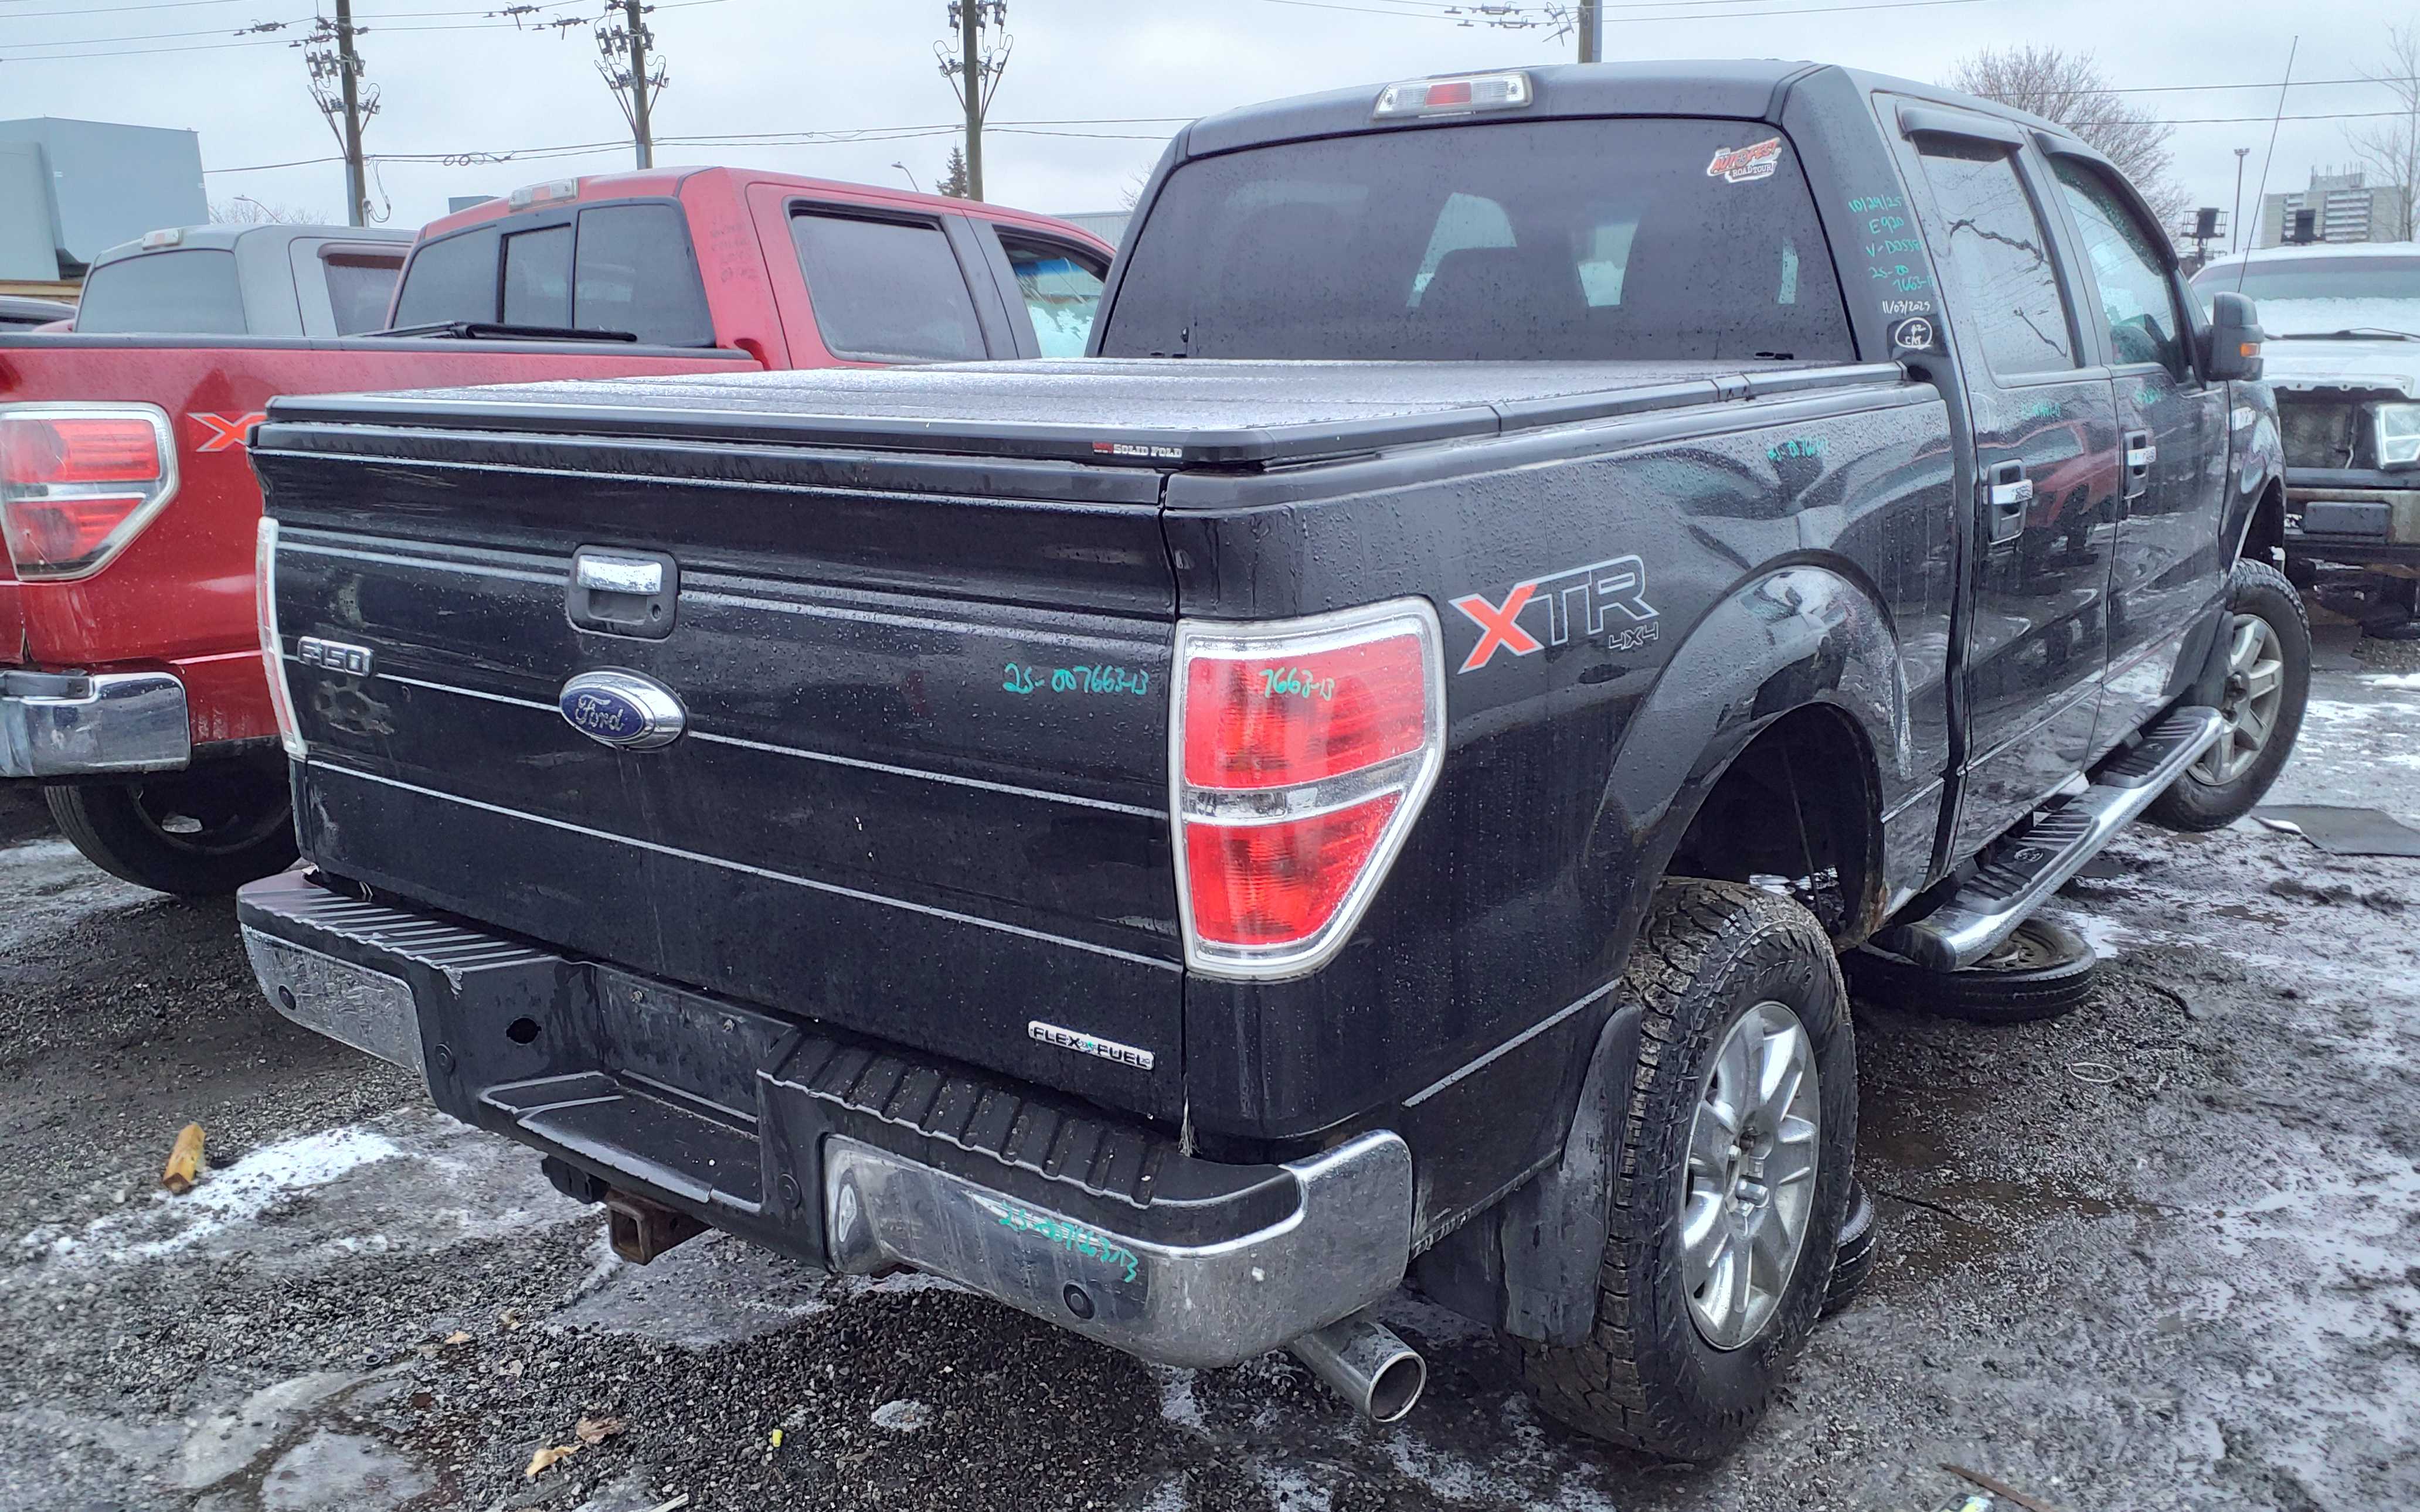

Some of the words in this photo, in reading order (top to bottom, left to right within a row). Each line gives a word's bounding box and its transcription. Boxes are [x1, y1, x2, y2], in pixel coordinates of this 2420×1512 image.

[1732, 166, 1752, 177] ROAD
[1113, 444, 1149, 456] SOLID
[1150, 446, 1182, 458] FOLD
[1448, 554, 1660, 676] XTR
[575, 694, 625, 731] Ford
[1034, 1027, 1081, 1050] FLEX
[1097, 1043, 1148, 1068] FUEL
